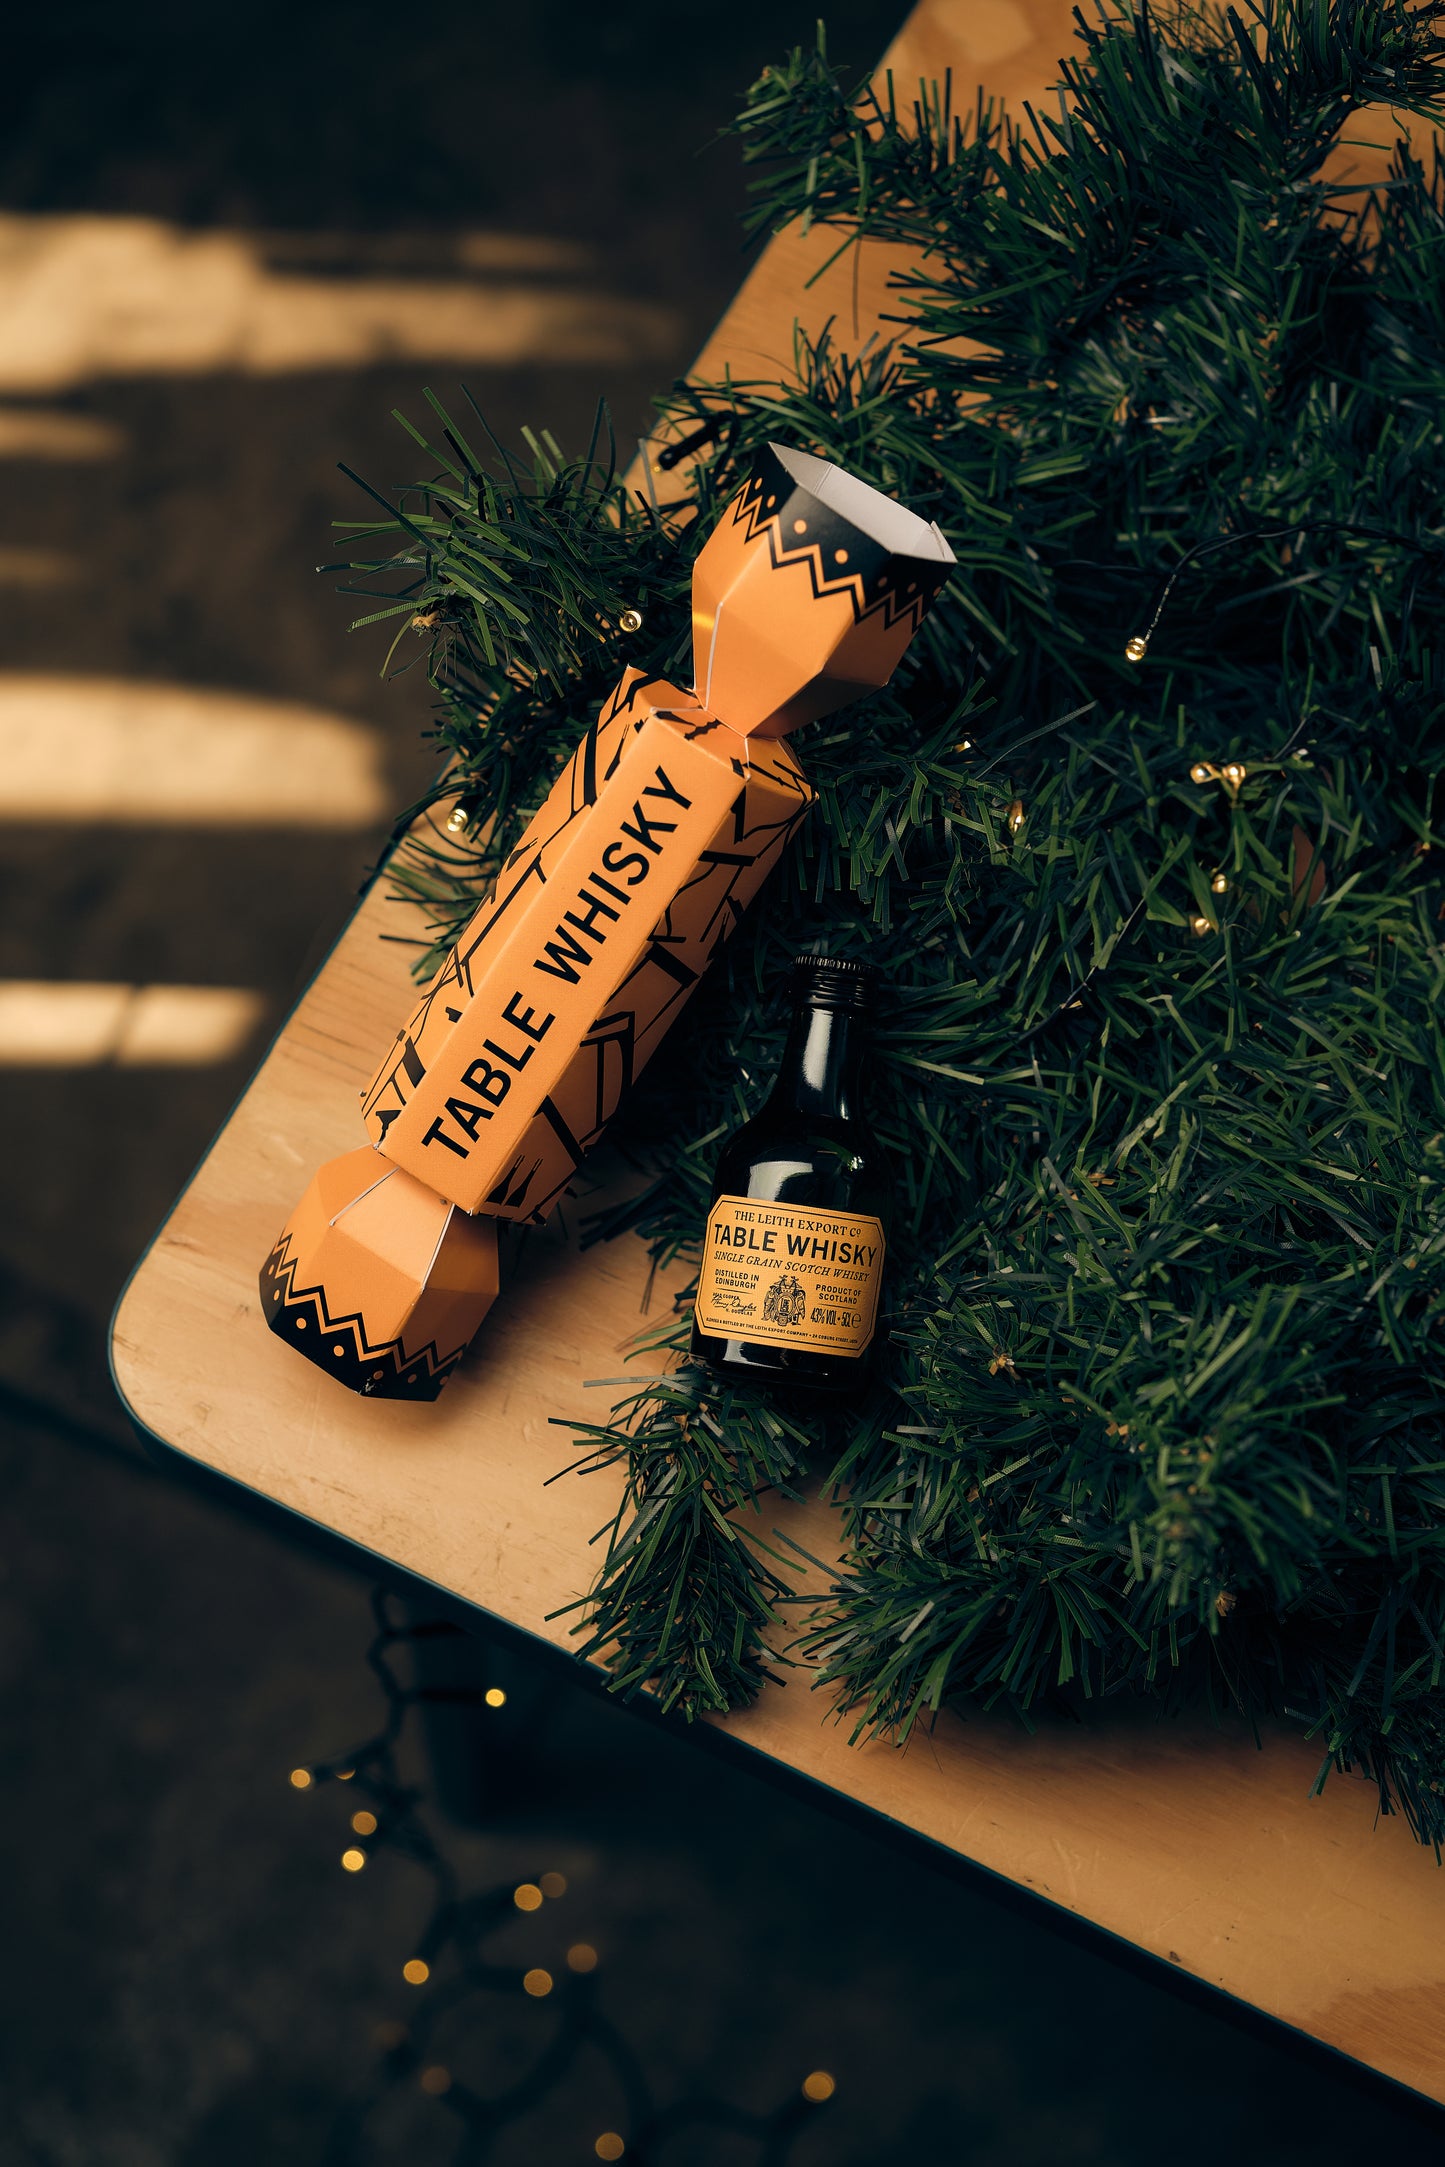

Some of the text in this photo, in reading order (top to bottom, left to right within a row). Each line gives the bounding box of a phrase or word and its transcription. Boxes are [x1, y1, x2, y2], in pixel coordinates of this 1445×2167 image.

[421, 765, 692, 1160] TABLE WHISKY
[735, 1210, 755, 1222] THE
[758, 1214, 794, 1228] LEITH
[798, 1219, 847, 1236] EXPORT
[714, 1223, 877, 1267] TABLE WHISKY
[714, 1250, 870, 1282] SINGLE GRAIN SCOTCH WHISKY
[715, 1268, 749, 1280] DISTILLED
[715, 1277, 756, 1289] EDINBURGH
[815, 1283, 862, 1297] PRODUCT OF
[818, 1292, 858, 1305] SCOTLAND
